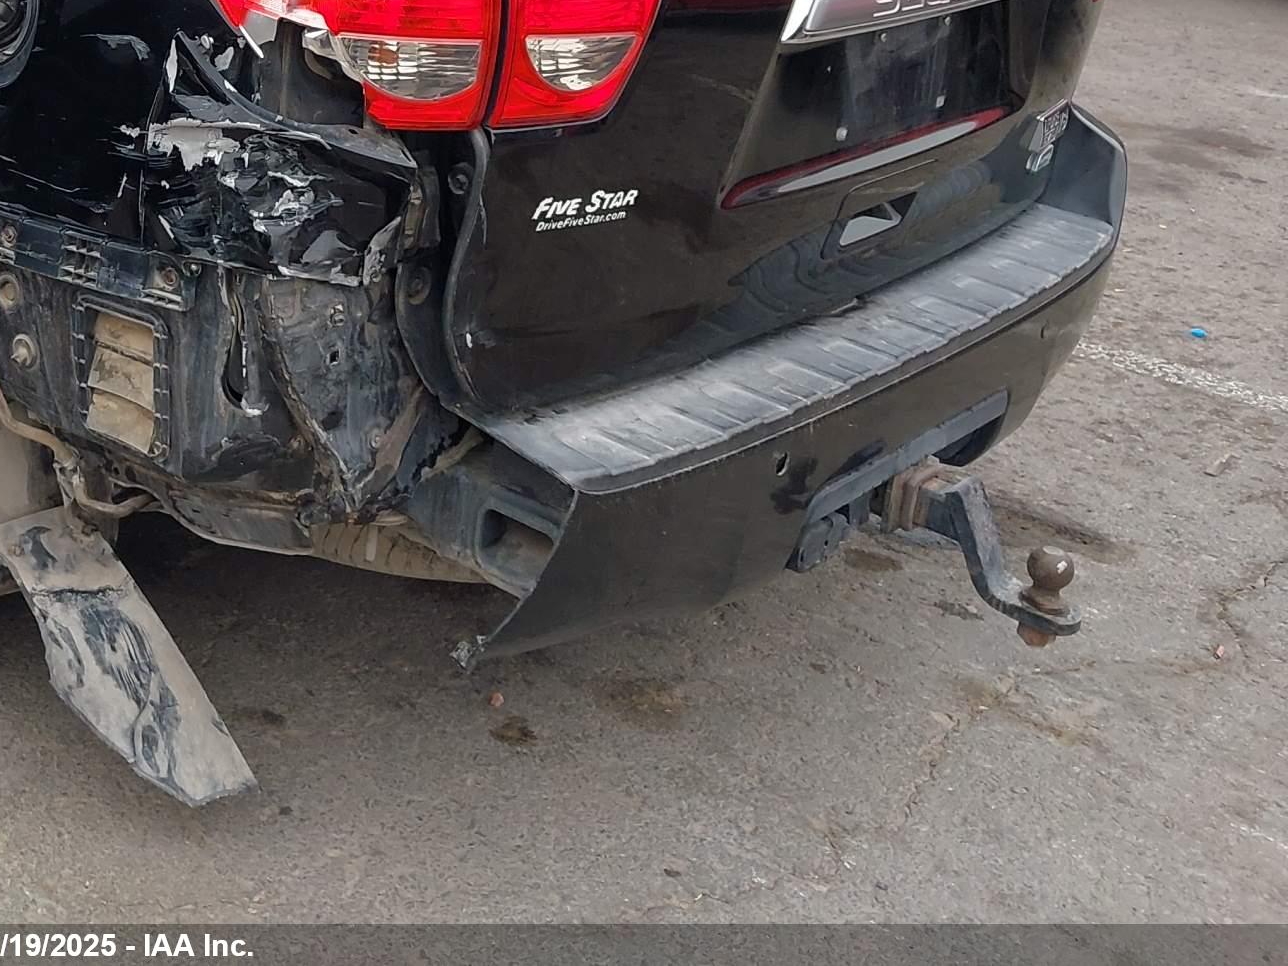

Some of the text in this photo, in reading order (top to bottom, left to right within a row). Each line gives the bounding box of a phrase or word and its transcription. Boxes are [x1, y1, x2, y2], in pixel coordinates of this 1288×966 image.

[531, 189, 640, 221] FIVE STAR
[534, 210, 627, 233] DriveFiveStar.com
